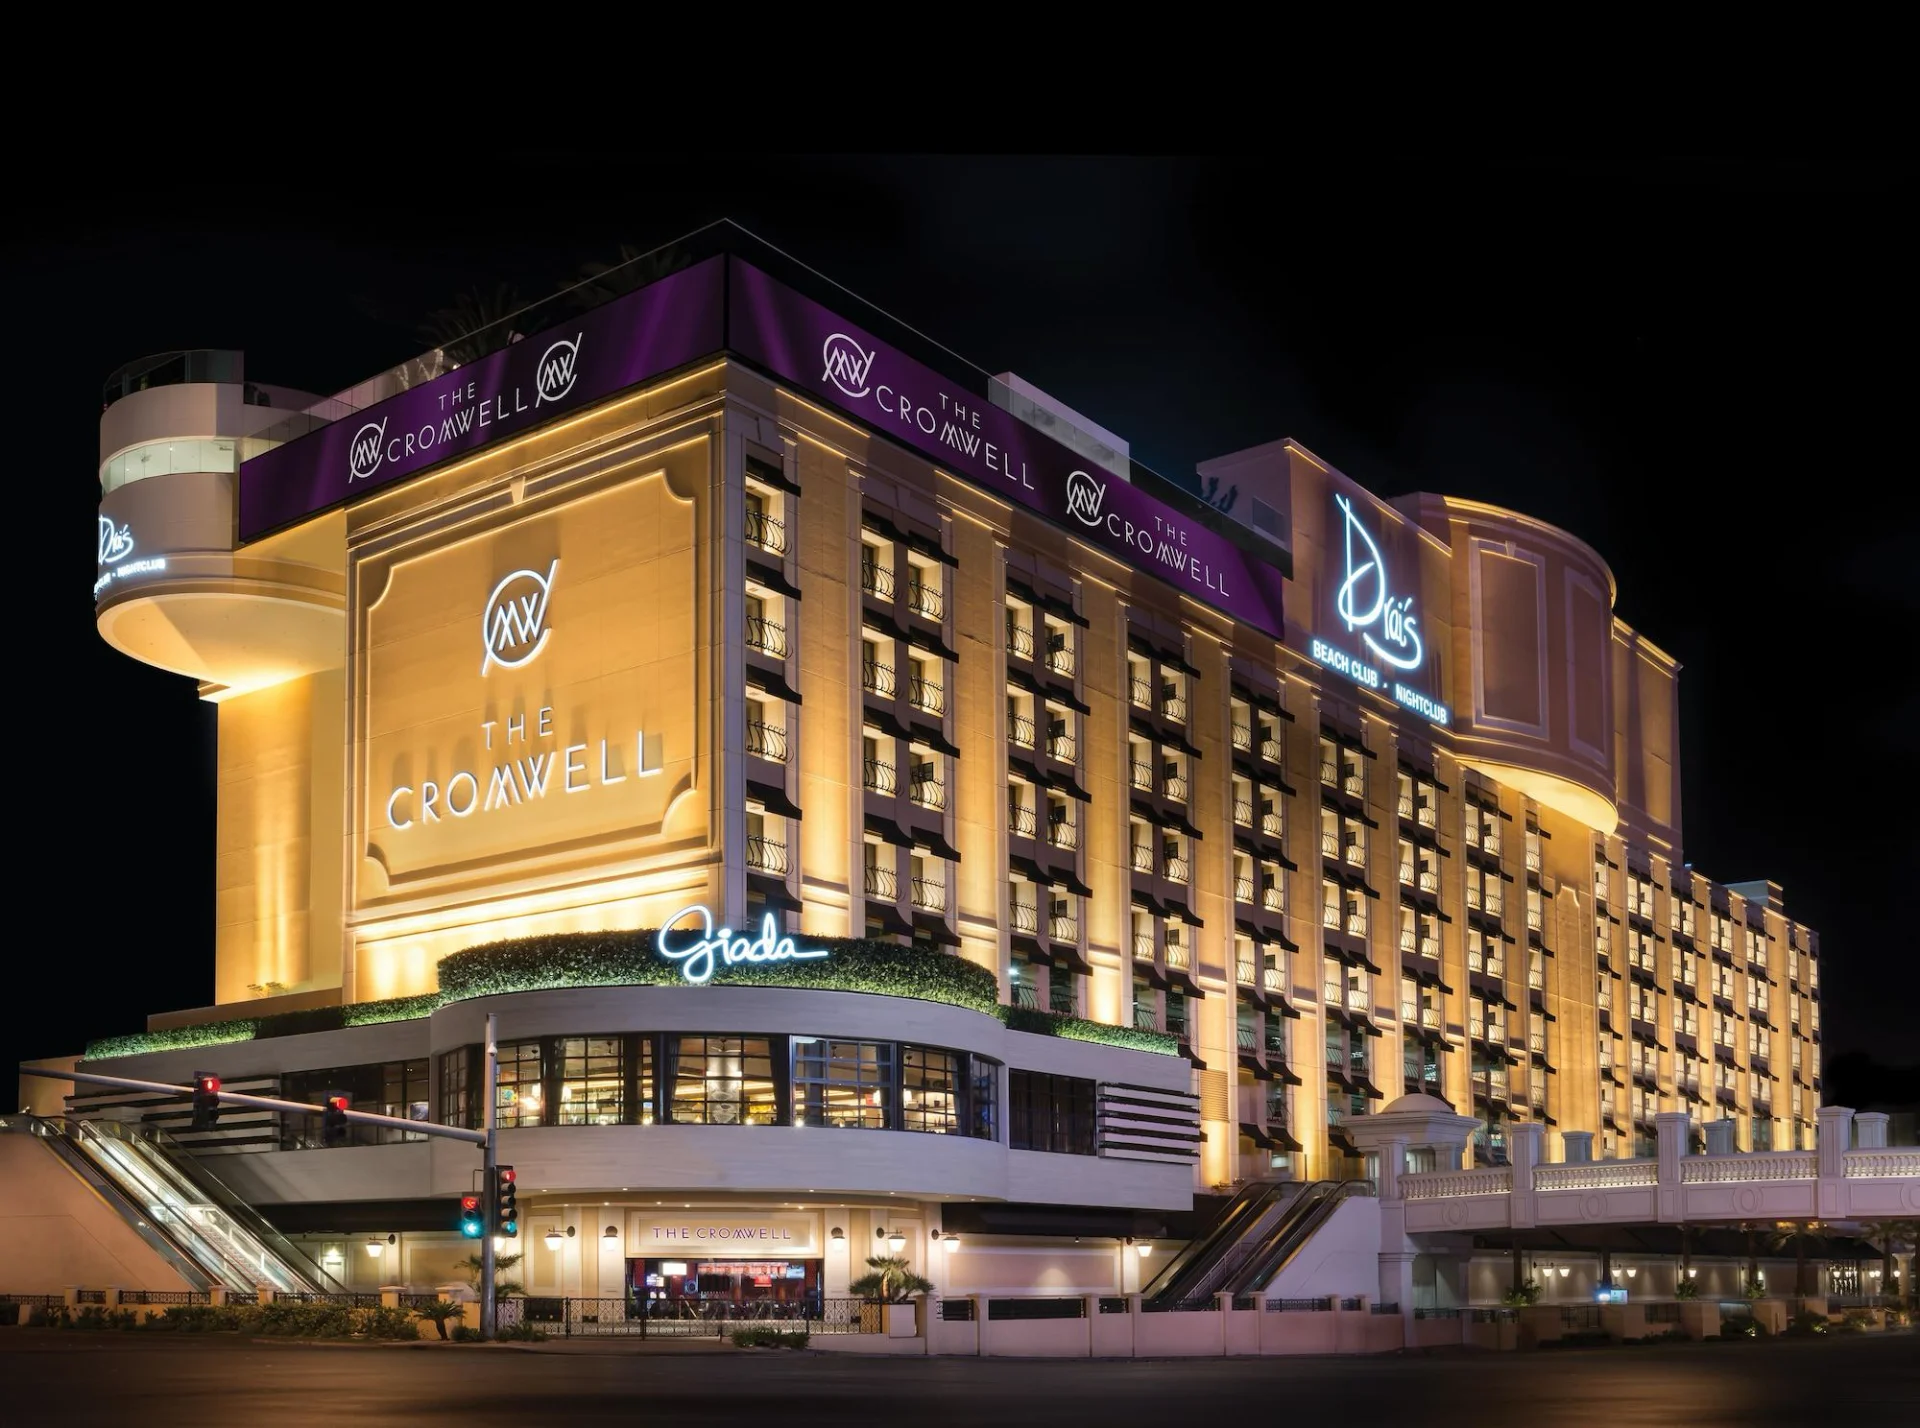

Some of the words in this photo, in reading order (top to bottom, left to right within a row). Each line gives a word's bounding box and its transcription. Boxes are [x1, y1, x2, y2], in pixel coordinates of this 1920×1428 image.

[387, 388, 528, 463] CROMWELL
[438, 382, 476, 411] THE
[939, 392, 981, 430] THE
[876, 385, 1035, 491] CROMWELL
[1107, 513, 1230, 597] CROMWELL
[1154, 516, 1188, 547] THE
[1312, 639, 1350, 674] BEACH
[1350, 660, 1379, 688] CLUB
[1395, 683, 1448, 725] NIGHTCLUB
[481, 707, 554, 750] THE
[387, 730, 663, 830] CROMWELL
[658, 904, 828, 983] Giada
[653, 1227, 689, 1239] THE
[696, 1227, 791, 1240] CROMWELL
